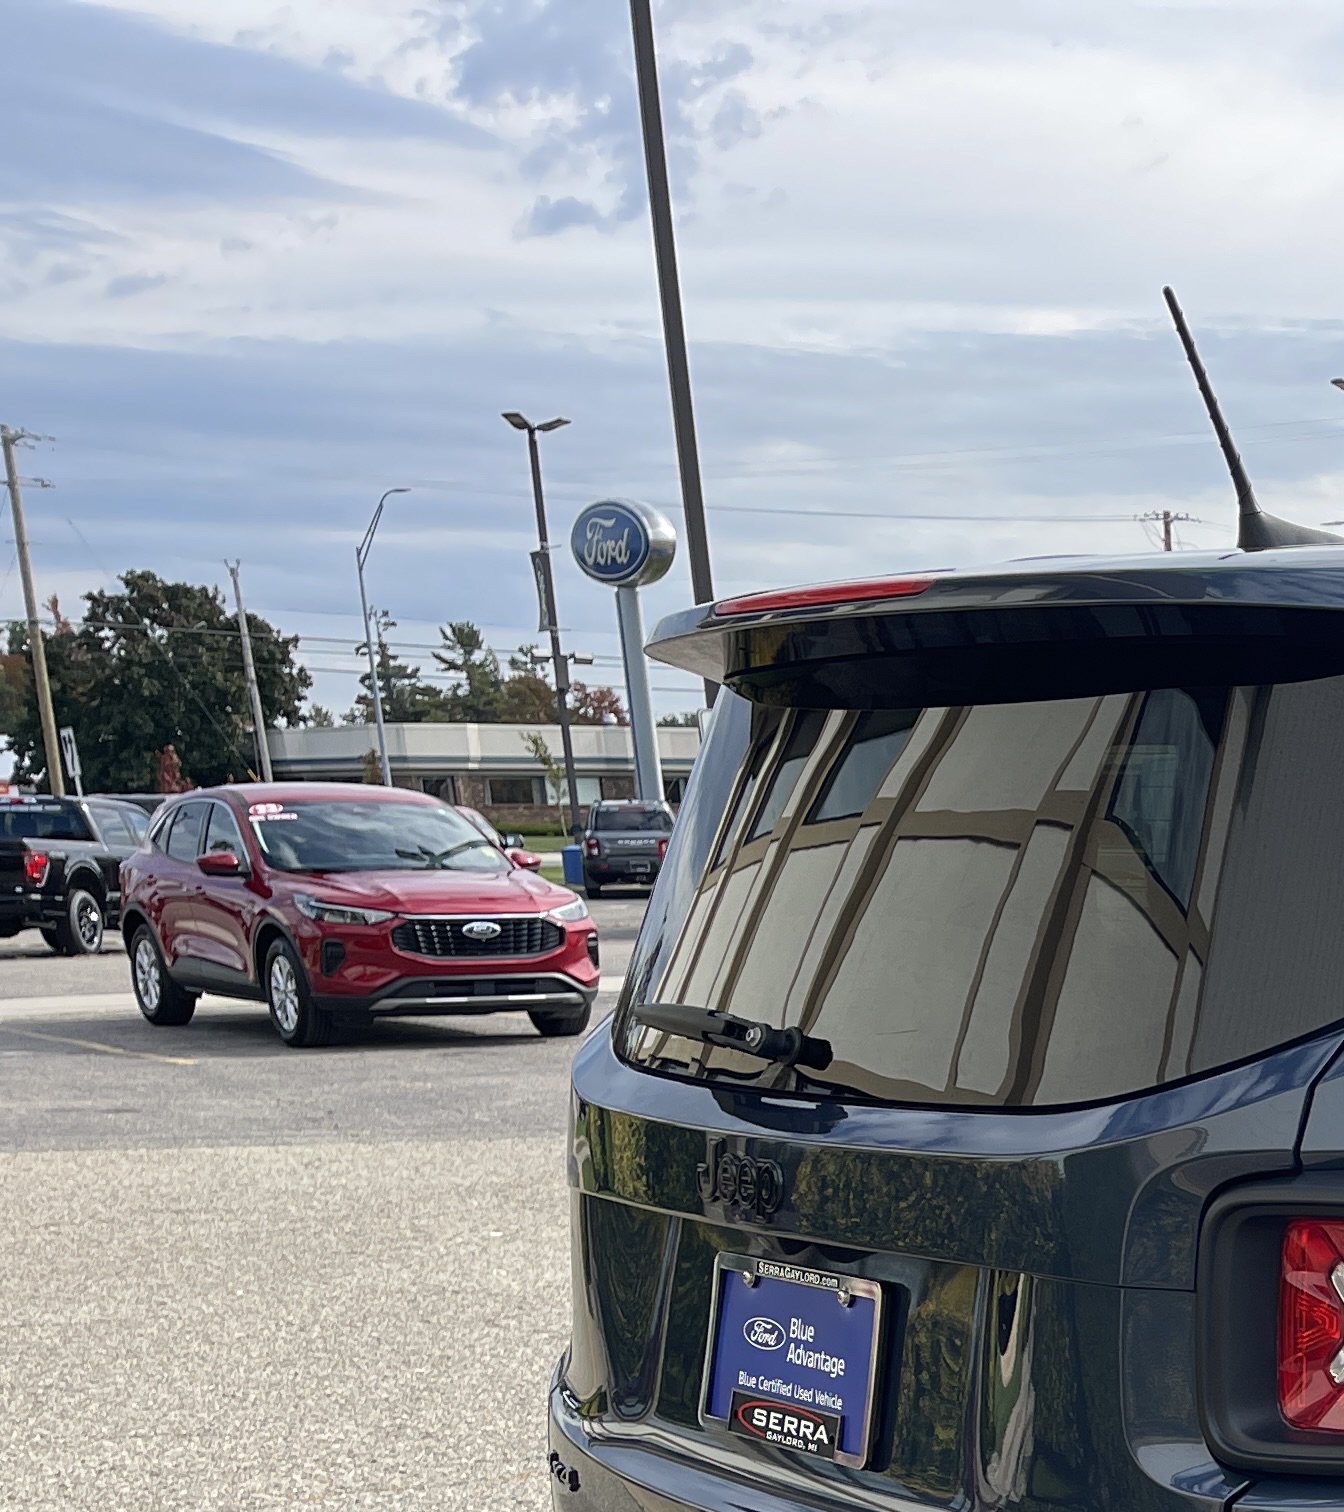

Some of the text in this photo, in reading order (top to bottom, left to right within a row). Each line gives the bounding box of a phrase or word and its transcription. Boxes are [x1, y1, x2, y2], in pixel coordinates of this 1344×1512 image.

[583, 517, 630, 566] Ford
[696, 1136, 784, 1224] Jeep
[751, 1320, 778, 1346] Ford
[789, 1317, 815, 1343] Blue
[786, 1343, 845, 1378] Advantage
[738, 1370, 842, 1411] Blue Certified Used Vehicle
[752, 1407, 829, 1445] SERRA
[807, 1441, 818, 1452] MI
